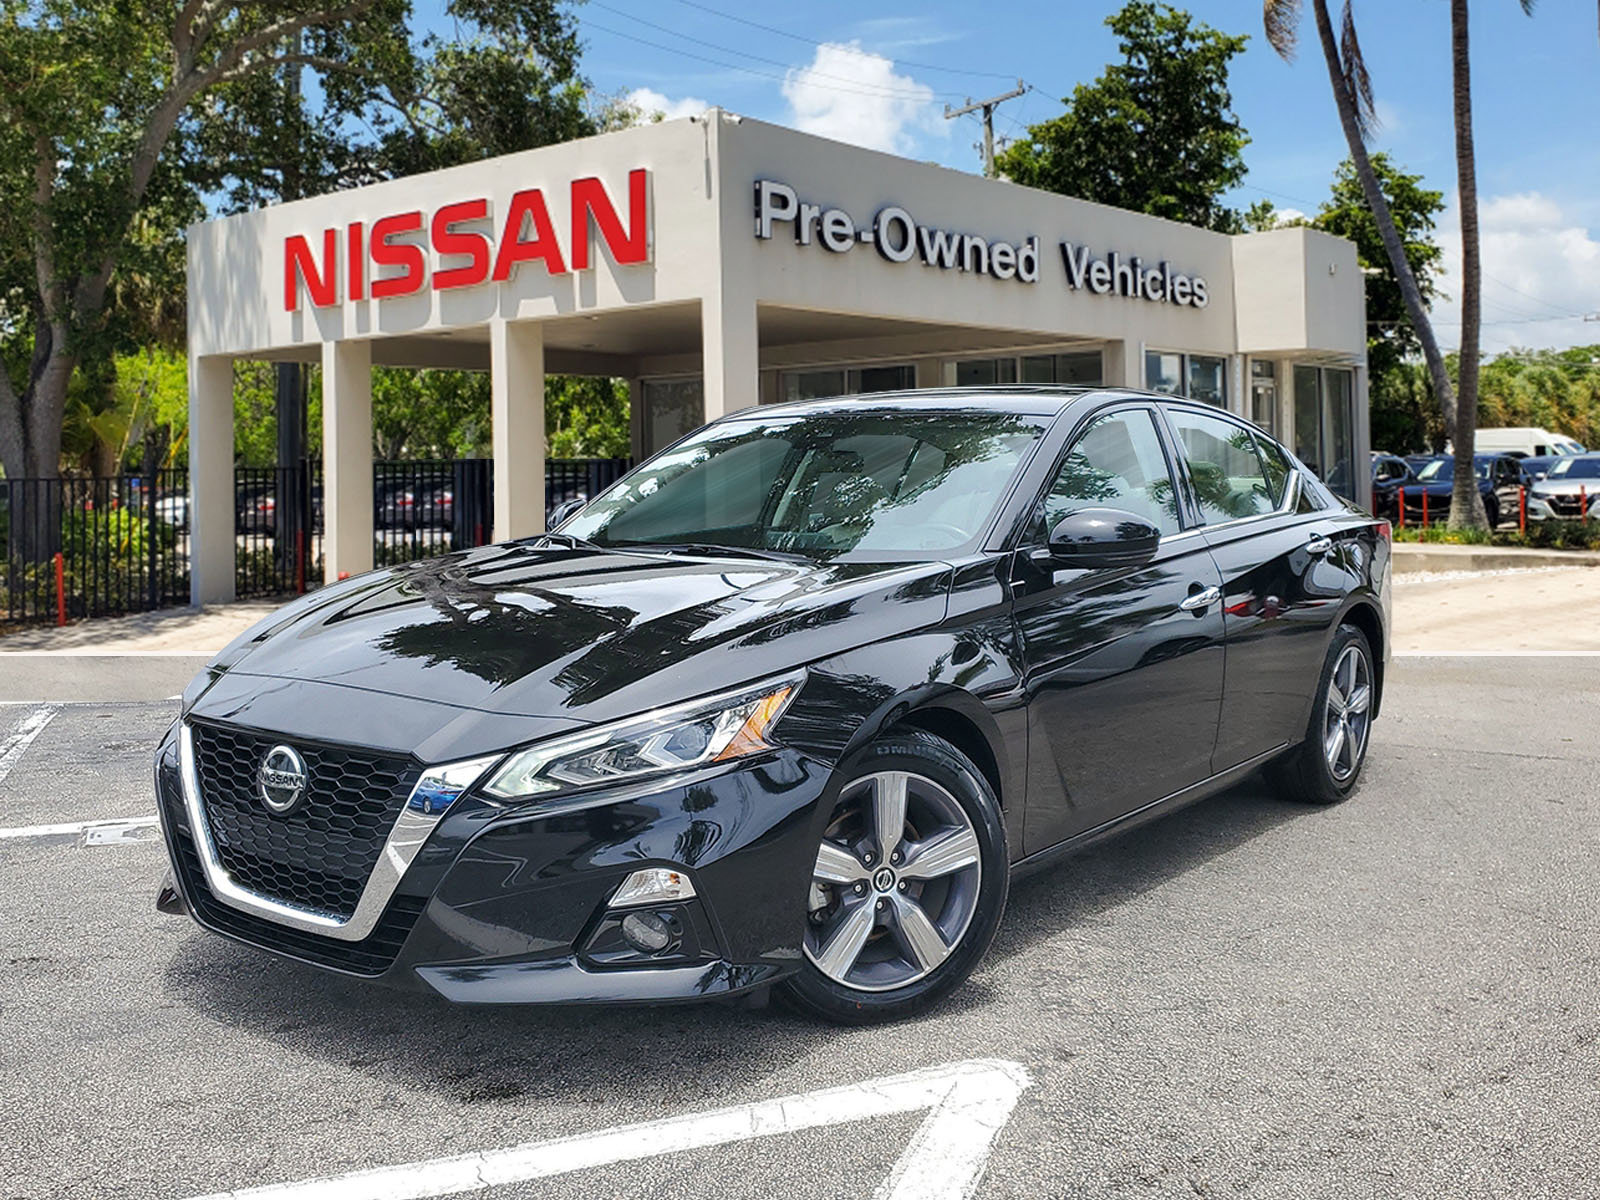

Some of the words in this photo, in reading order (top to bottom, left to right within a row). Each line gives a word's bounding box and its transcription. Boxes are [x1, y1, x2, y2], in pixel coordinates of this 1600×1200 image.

[285, 168, 648, 311] NISSAN
[754, 180, 1040, 283] Pre-Owned
[1060, 242, 1209, 308] Vehicles
